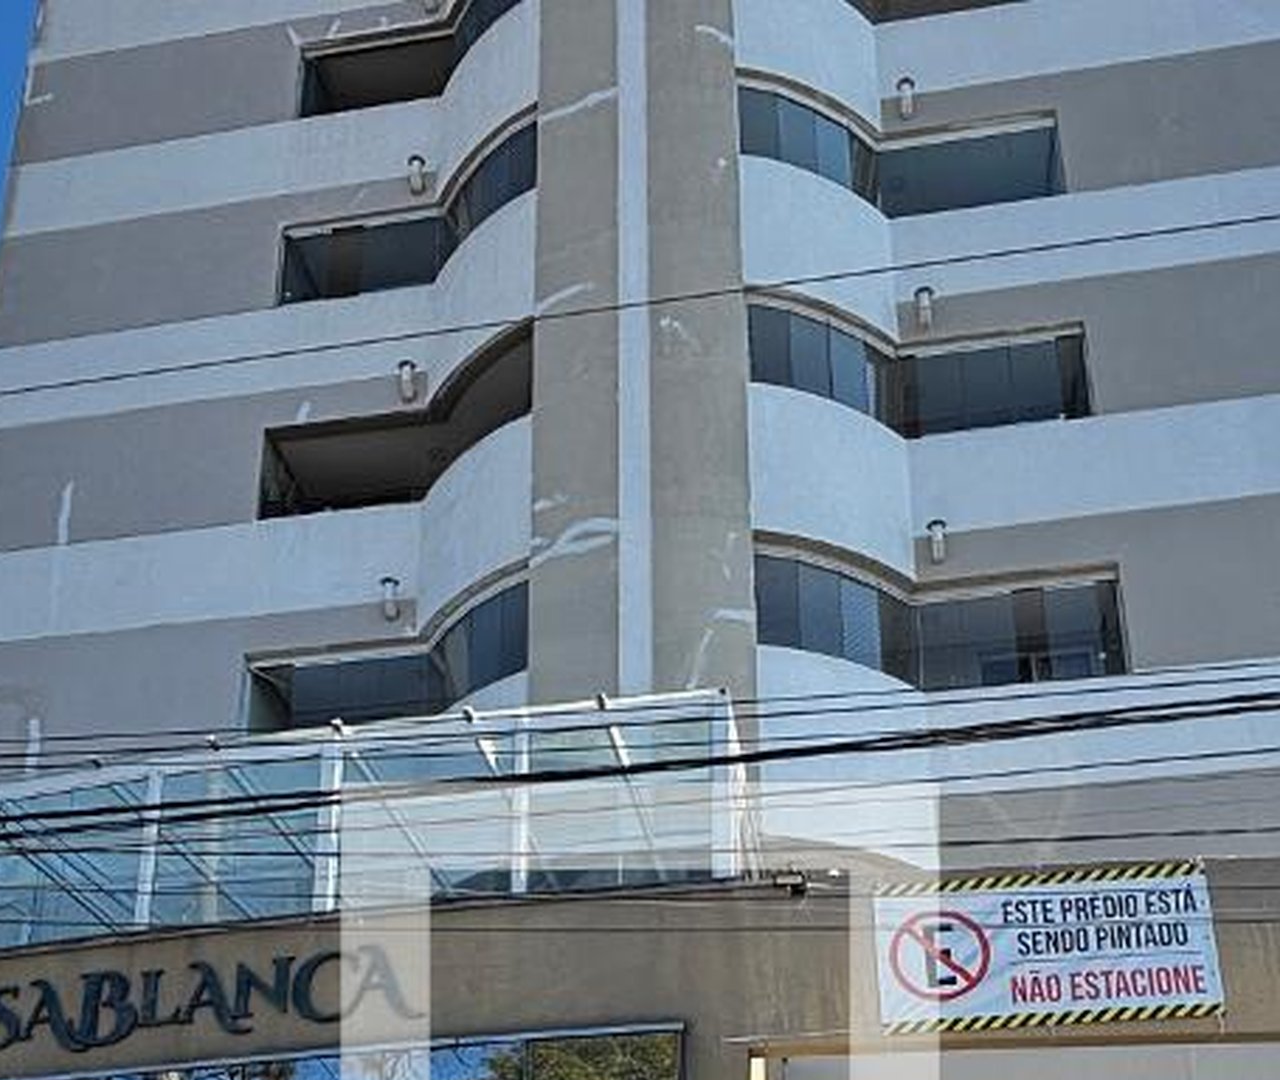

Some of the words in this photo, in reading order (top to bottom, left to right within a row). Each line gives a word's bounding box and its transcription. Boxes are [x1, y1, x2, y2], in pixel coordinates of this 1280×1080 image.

[1001, 899, 1055, 925] ESTE
[1061, 892, 1138, 922] PRÉDIO
[1145, 884, 1198, 916] ESTÁ
[1017, 927, 1090, 957] SENDO
[1096, 922, 1189, 951] PINTADO
[1011, 969, 1063, 1005] NÃO
[1070, 965, 1208, 1001] ESTACIONE
